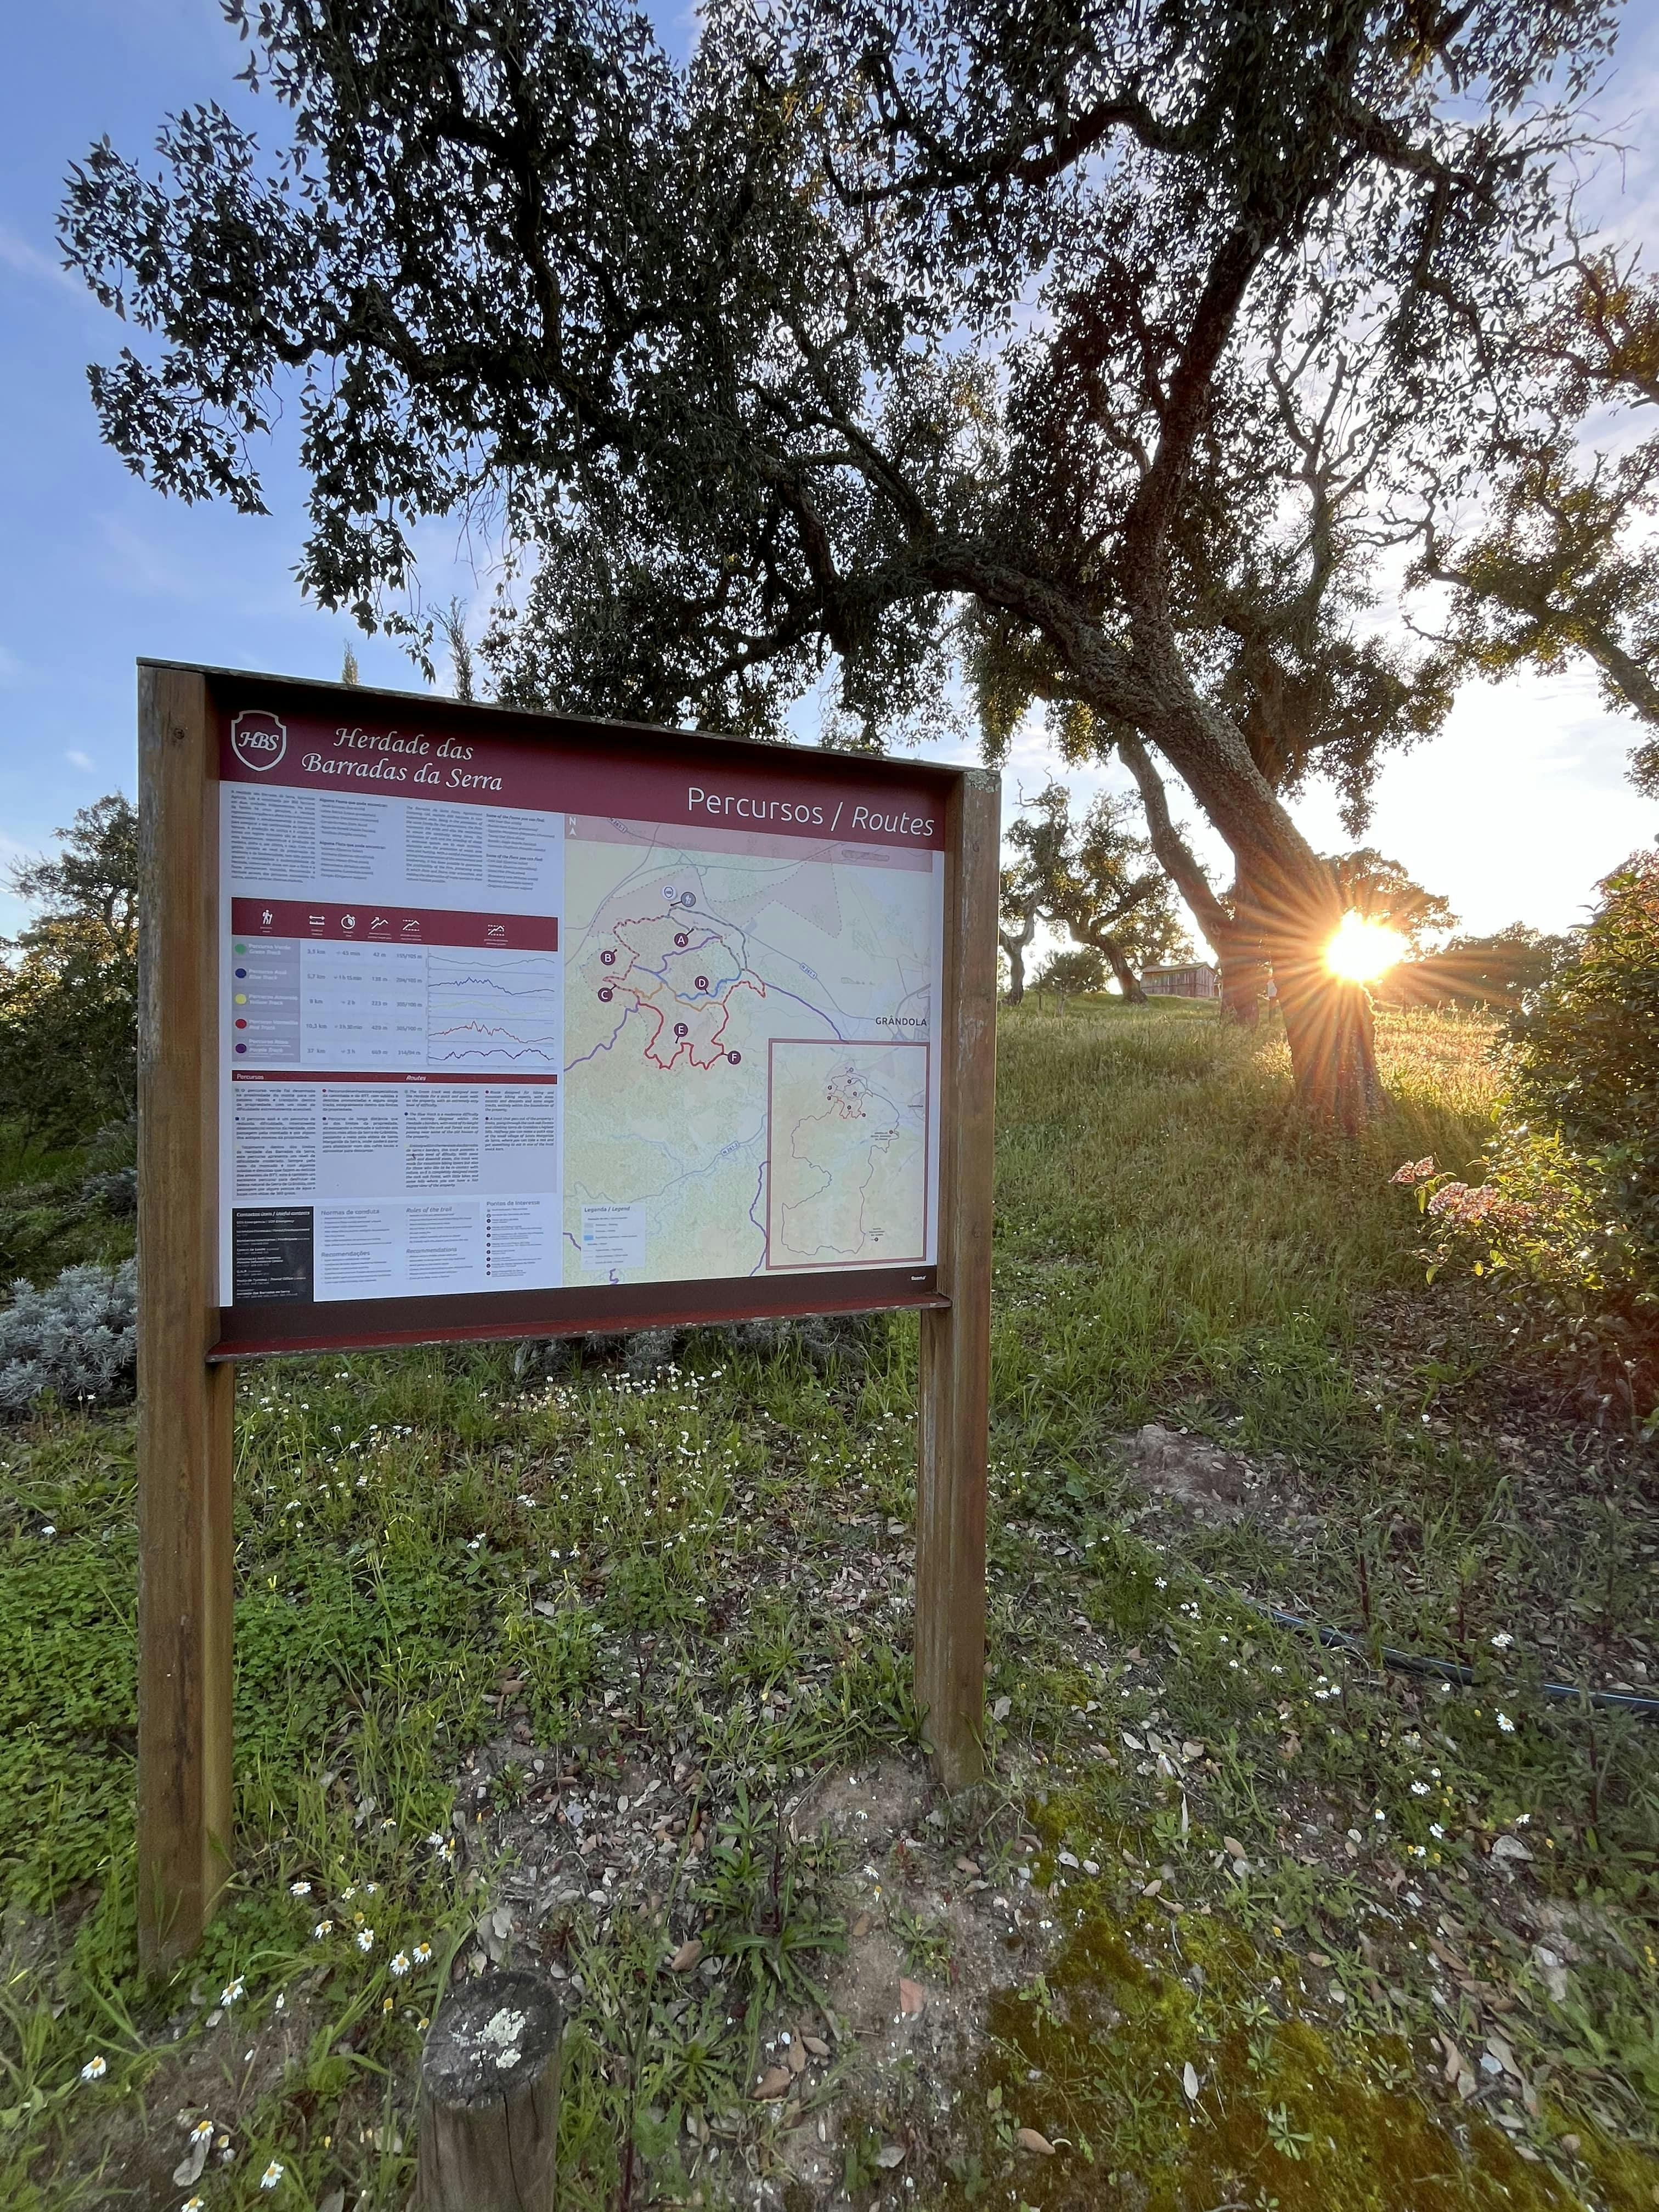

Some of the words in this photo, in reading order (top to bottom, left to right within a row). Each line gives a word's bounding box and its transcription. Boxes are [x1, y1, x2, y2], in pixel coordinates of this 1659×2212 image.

[238, 732, 279, 752] HBS
[333, 727, 431, 755] Herdade
[436, 737, 474, 760] das
[302, 753, 408, 781] Barradas
[414, 763, 441, 785] da
[445, 768, 503, 791] Serra
[688, 787, 823, 825] Percursos
[831, 802, 843, 831] /
[851, 806, 935, 837] Routes
[569, 816, 576, 825] N
[678, 936, 685, 945] A
[605, 953, 612, 962] B
[805, 968, 816, 978] 261-1
[698, 978, 706, 987] D
[601, 990, 609, 999] C
[876, 1015, 927, 1026] GRÂNDOLA
[678, 1026, 684, 1034] E
[732, 1053, 737, 1062] F
